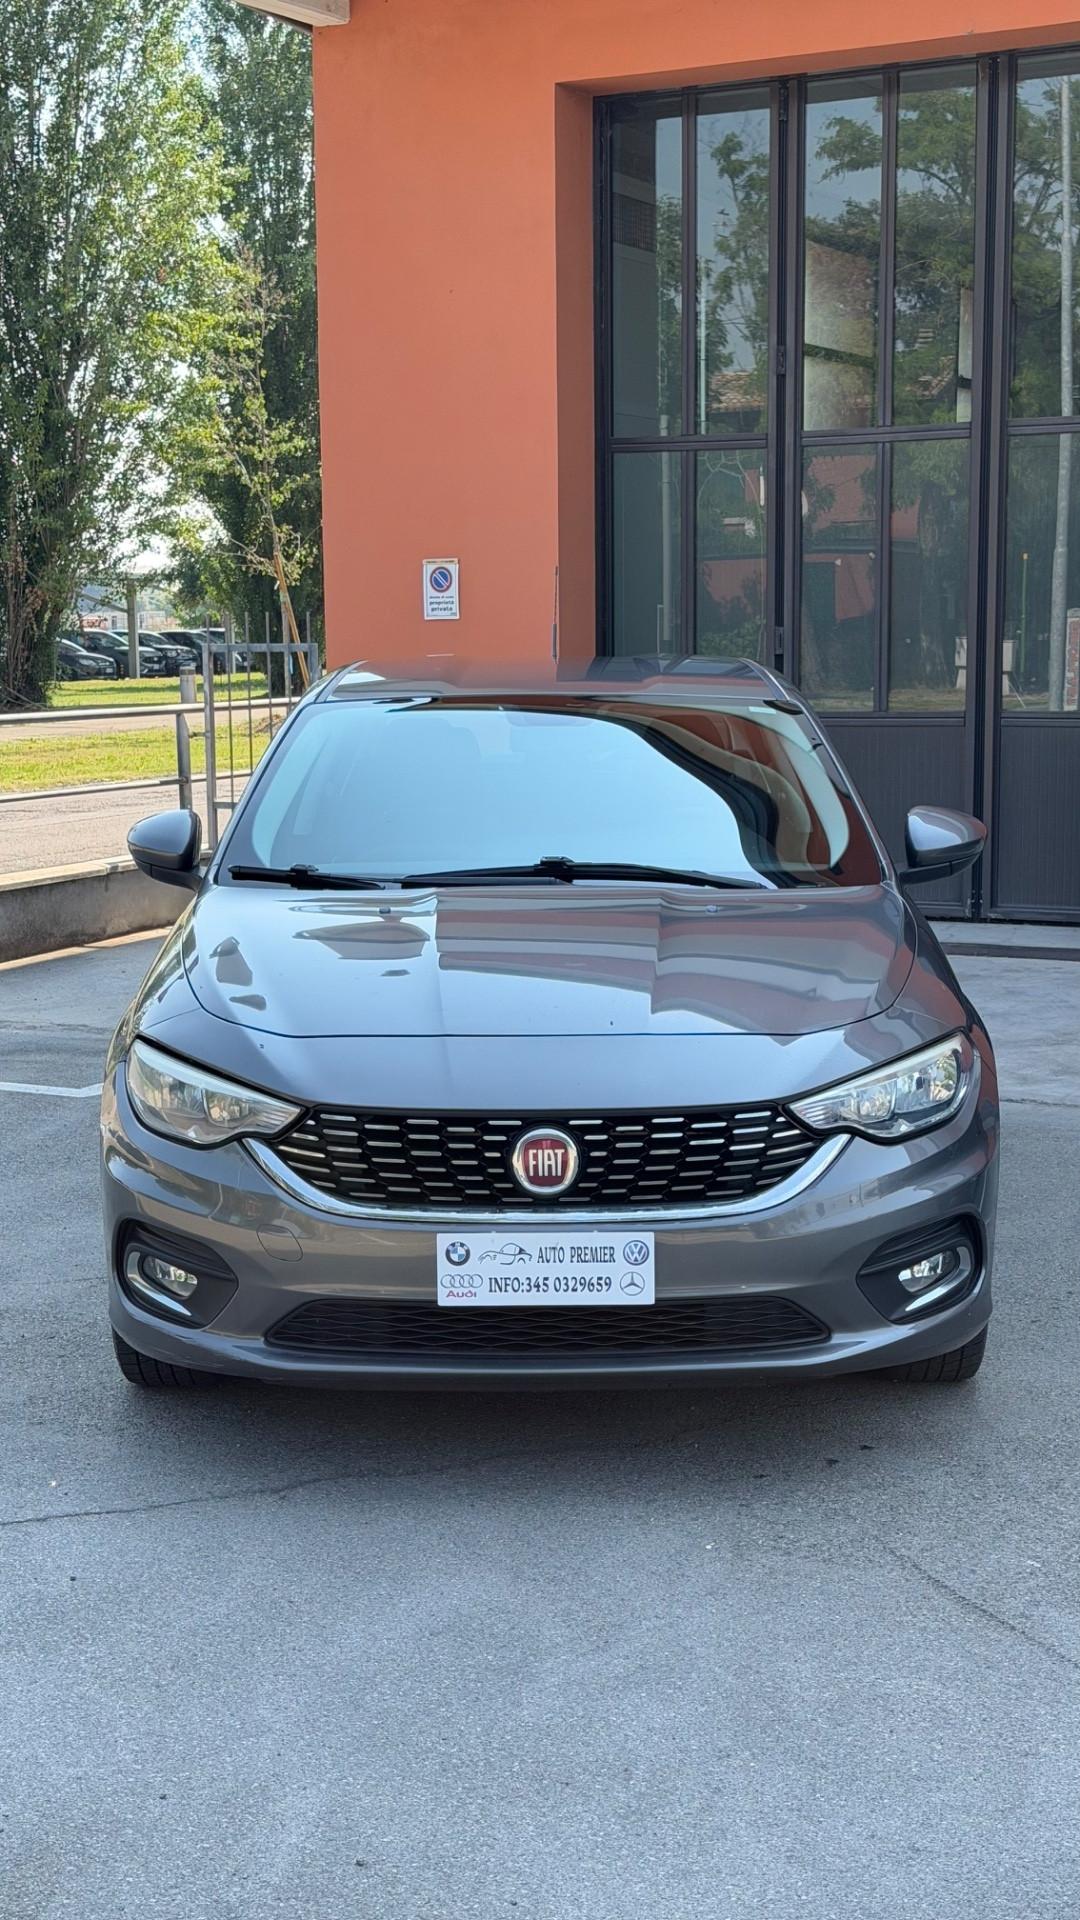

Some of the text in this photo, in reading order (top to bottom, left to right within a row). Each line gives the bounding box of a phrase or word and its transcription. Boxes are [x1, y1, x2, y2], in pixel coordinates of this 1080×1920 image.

[528, 1149, 565, 1177] FIAT
[537, 1246, 616, 1263] AUTO PREMIER
[488, 1276, 612, 1293] INFO:345 0329659
[446, 1290, 477, 1298] Audi
